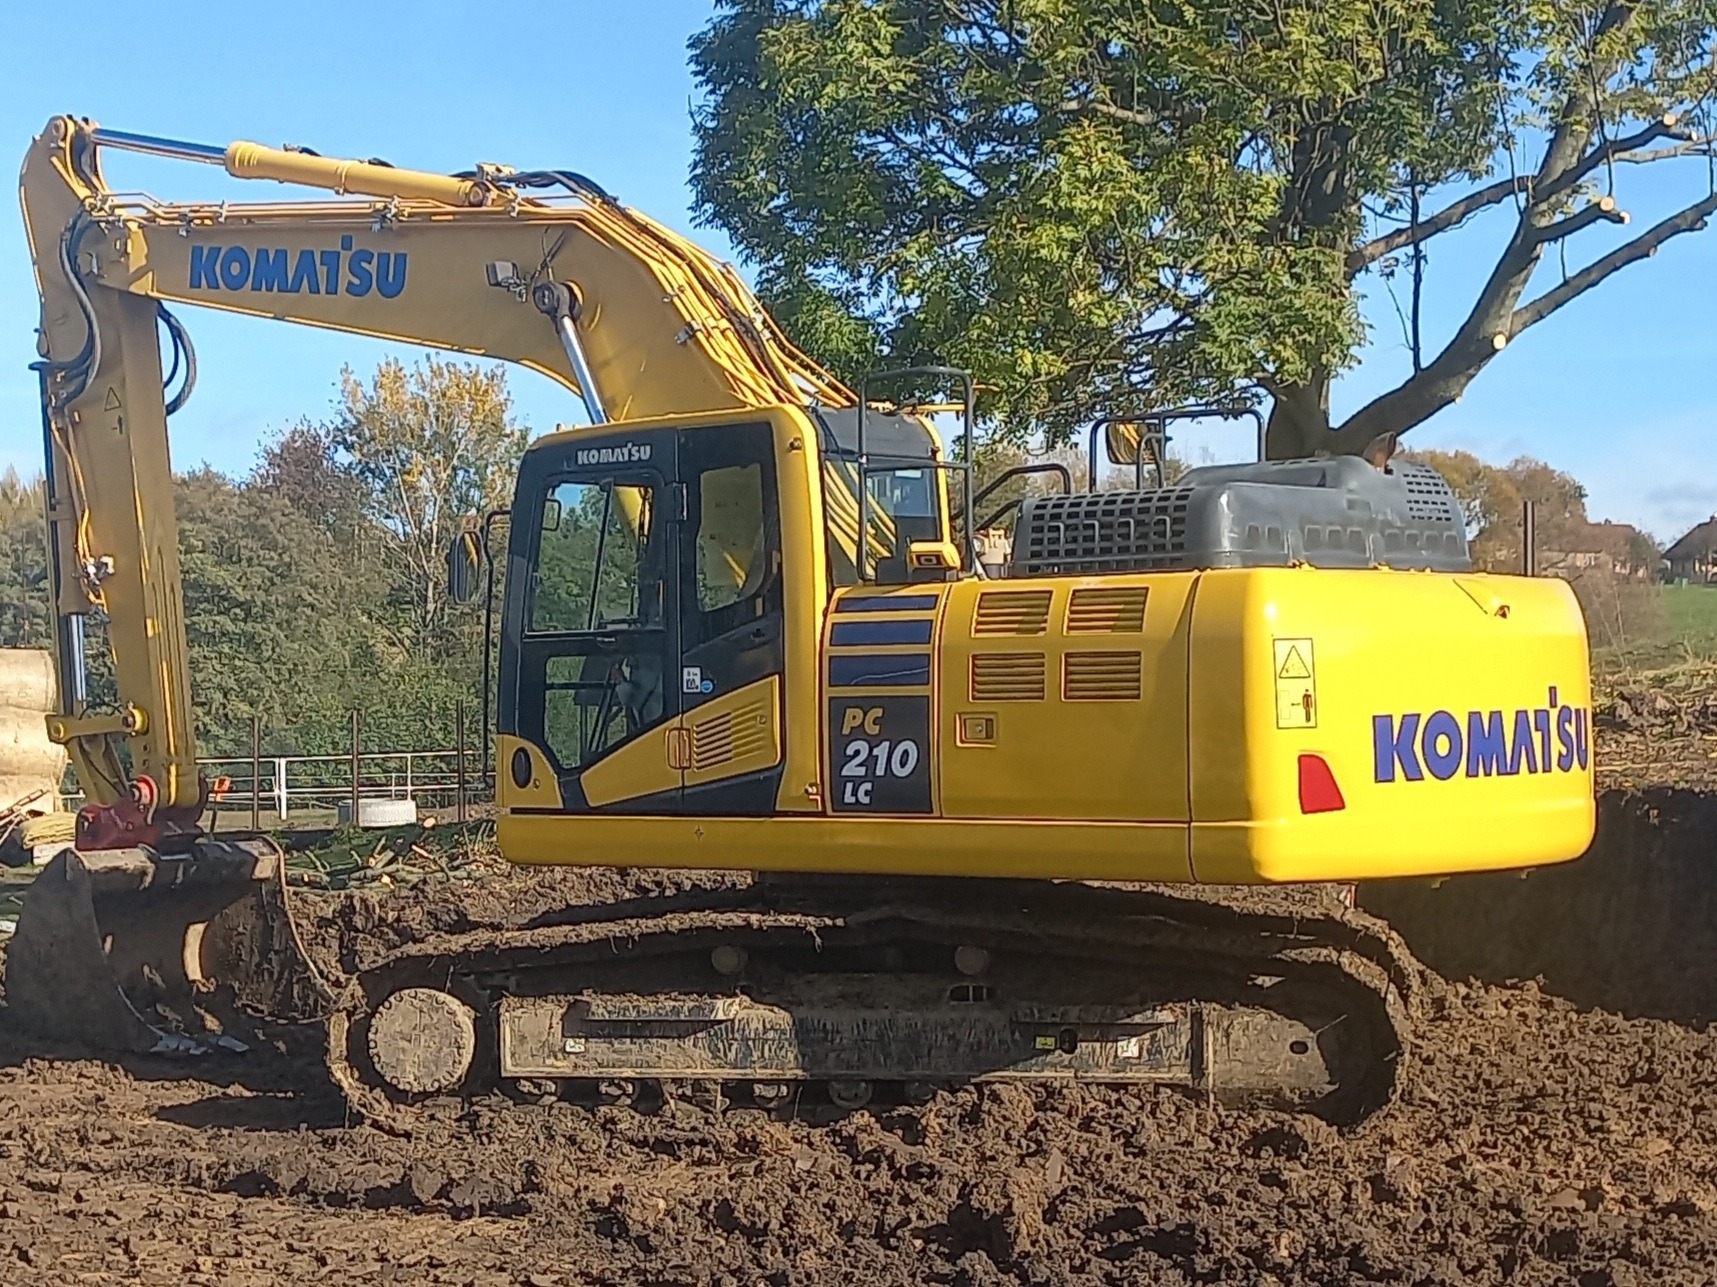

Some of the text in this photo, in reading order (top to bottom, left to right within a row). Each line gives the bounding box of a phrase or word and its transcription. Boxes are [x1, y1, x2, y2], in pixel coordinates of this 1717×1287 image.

[189, 234, 407, 298] KOMATSU
[577, 442, 651, 465] KOMATSU
[841, 708, 883, 735] PC
[1372, 686, 1588, 783] KOMATSU
[840, 740, 918, 777] 210
[843, 782, 872, 804] LC
